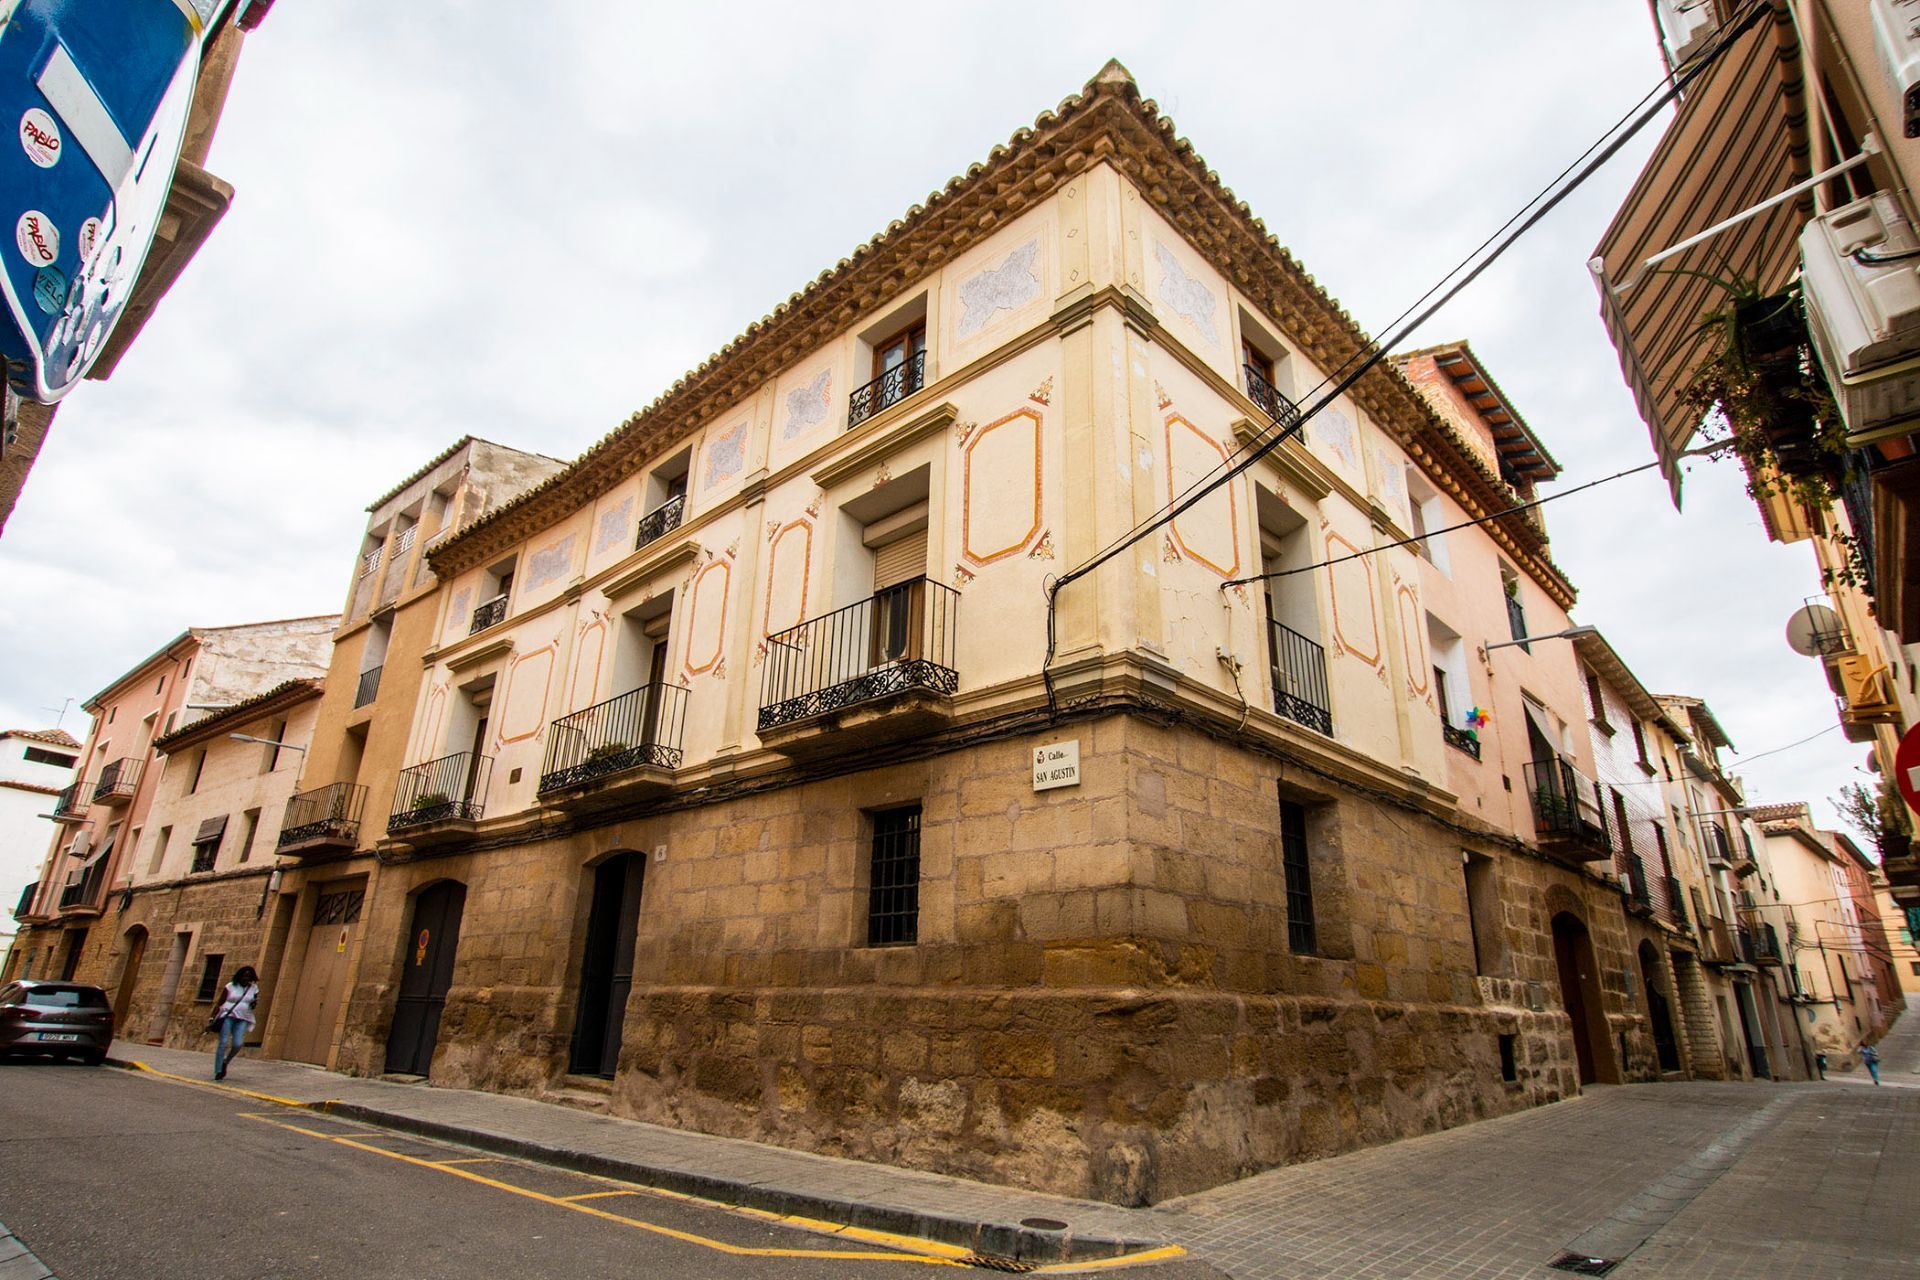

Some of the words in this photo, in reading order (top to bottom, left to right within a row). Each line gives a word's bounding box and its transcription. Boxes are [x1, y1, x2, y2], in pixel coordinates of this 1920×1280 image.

[24, 120, 60, 151] PABLO
[26, 216, 54, 261] PABLO
[1048, 750, 1068, 761] Calle
[1036, 771, 1047, 784] SAN
